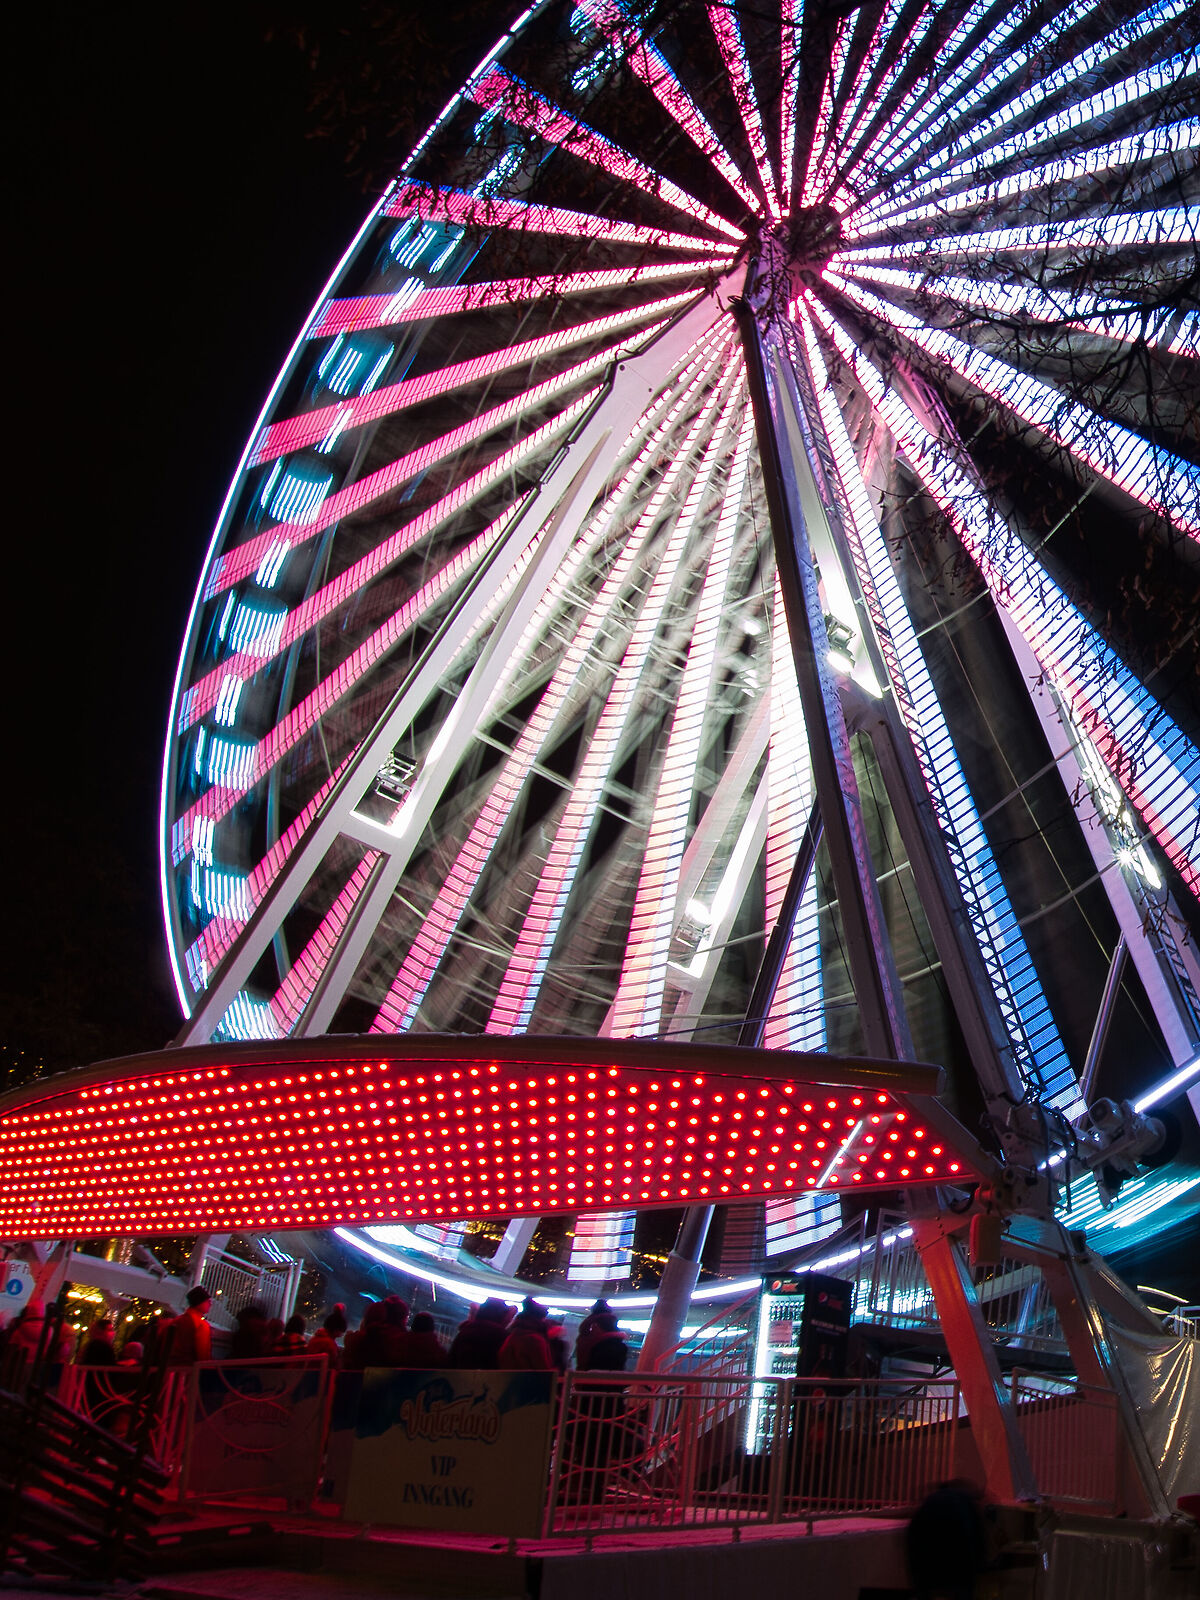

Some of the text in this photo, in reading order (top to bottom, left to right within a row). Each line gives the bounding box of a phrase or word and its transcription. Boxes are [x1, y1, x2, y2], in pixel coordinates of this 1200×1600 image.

[401, 1389, 499, 1440] Vinterland
[431, 1455, 457, 1476] VIP
[402, 1483, 474, 1508] INNGANG
